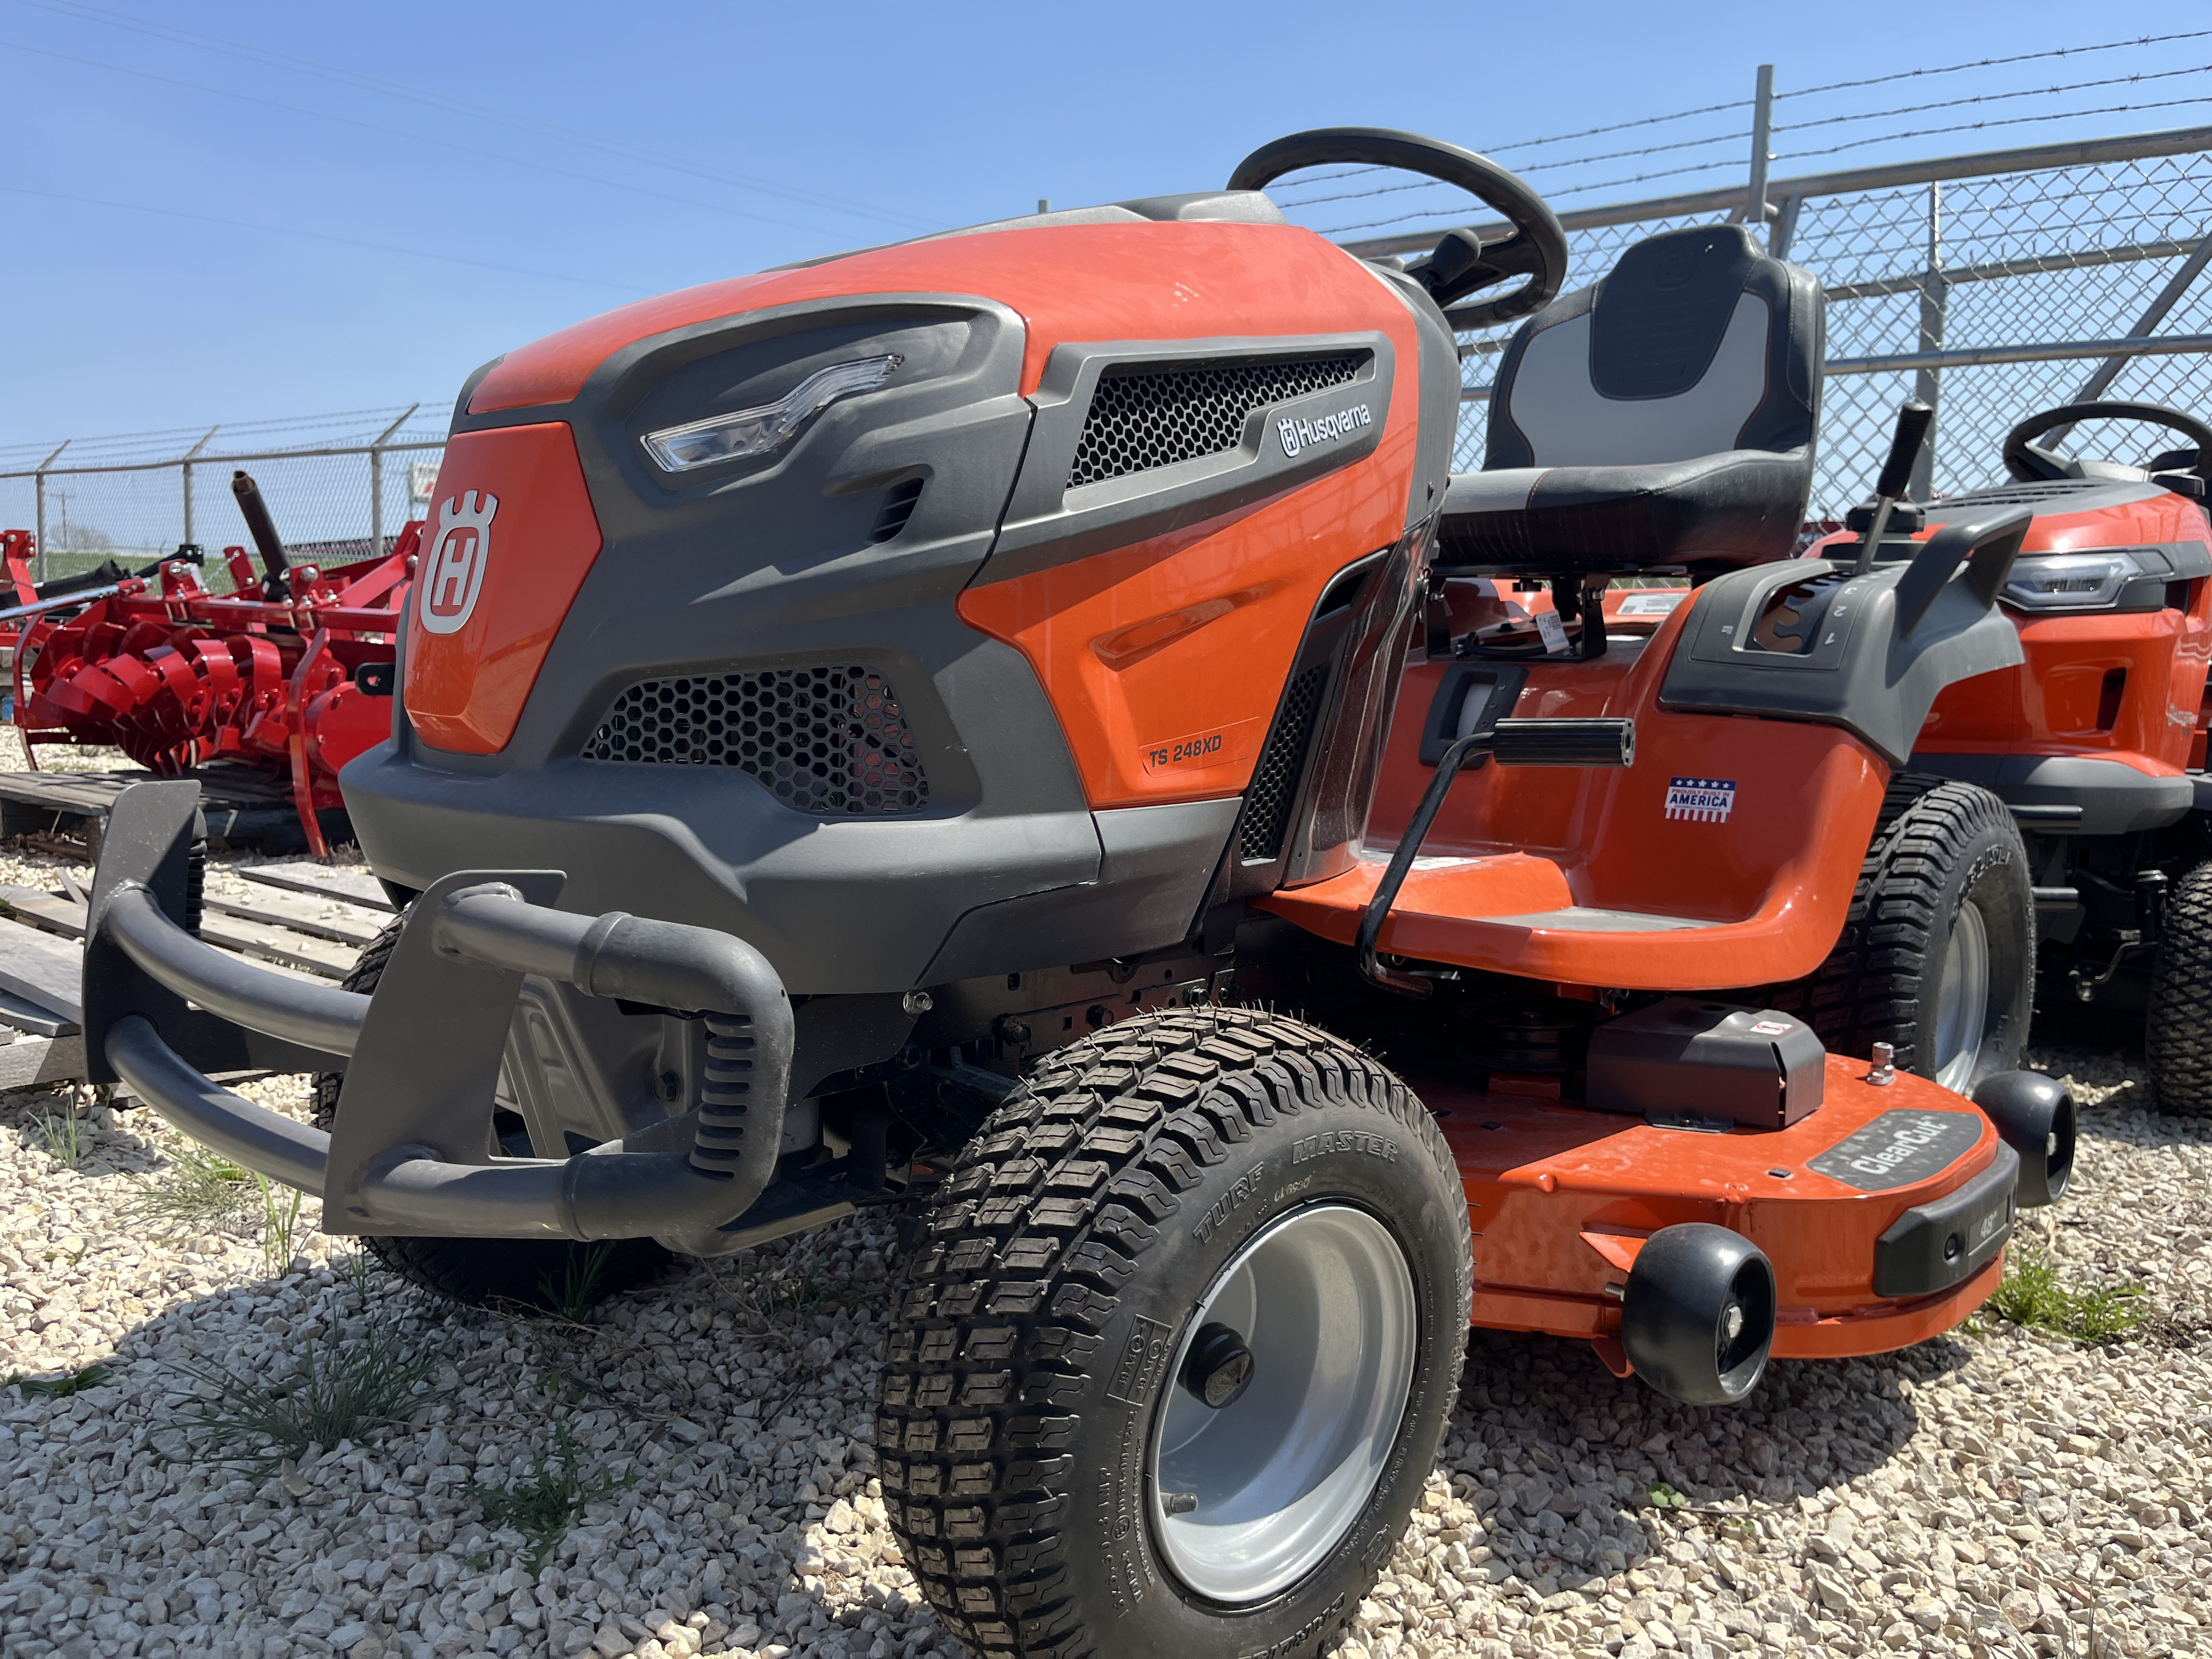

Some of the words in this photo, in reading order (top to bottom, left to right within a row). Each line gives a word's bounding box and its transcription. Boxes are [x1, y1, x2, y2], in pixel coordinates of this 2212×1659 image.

[1295, 404, 1371, 447] Husqvarna
[1833, 606, 1847, 617] 2
[1150, 749, 1167, 768] TS
[1173, 735, 1222, 762] 248XD
[1669, 794, 1727, 808] AMERICA
[1850, 1120, 1948, 1175] ClearCut
[1192, 1160, 1264, 1244] TURF
[1291, 1130, 1398, 1165] MASTER
